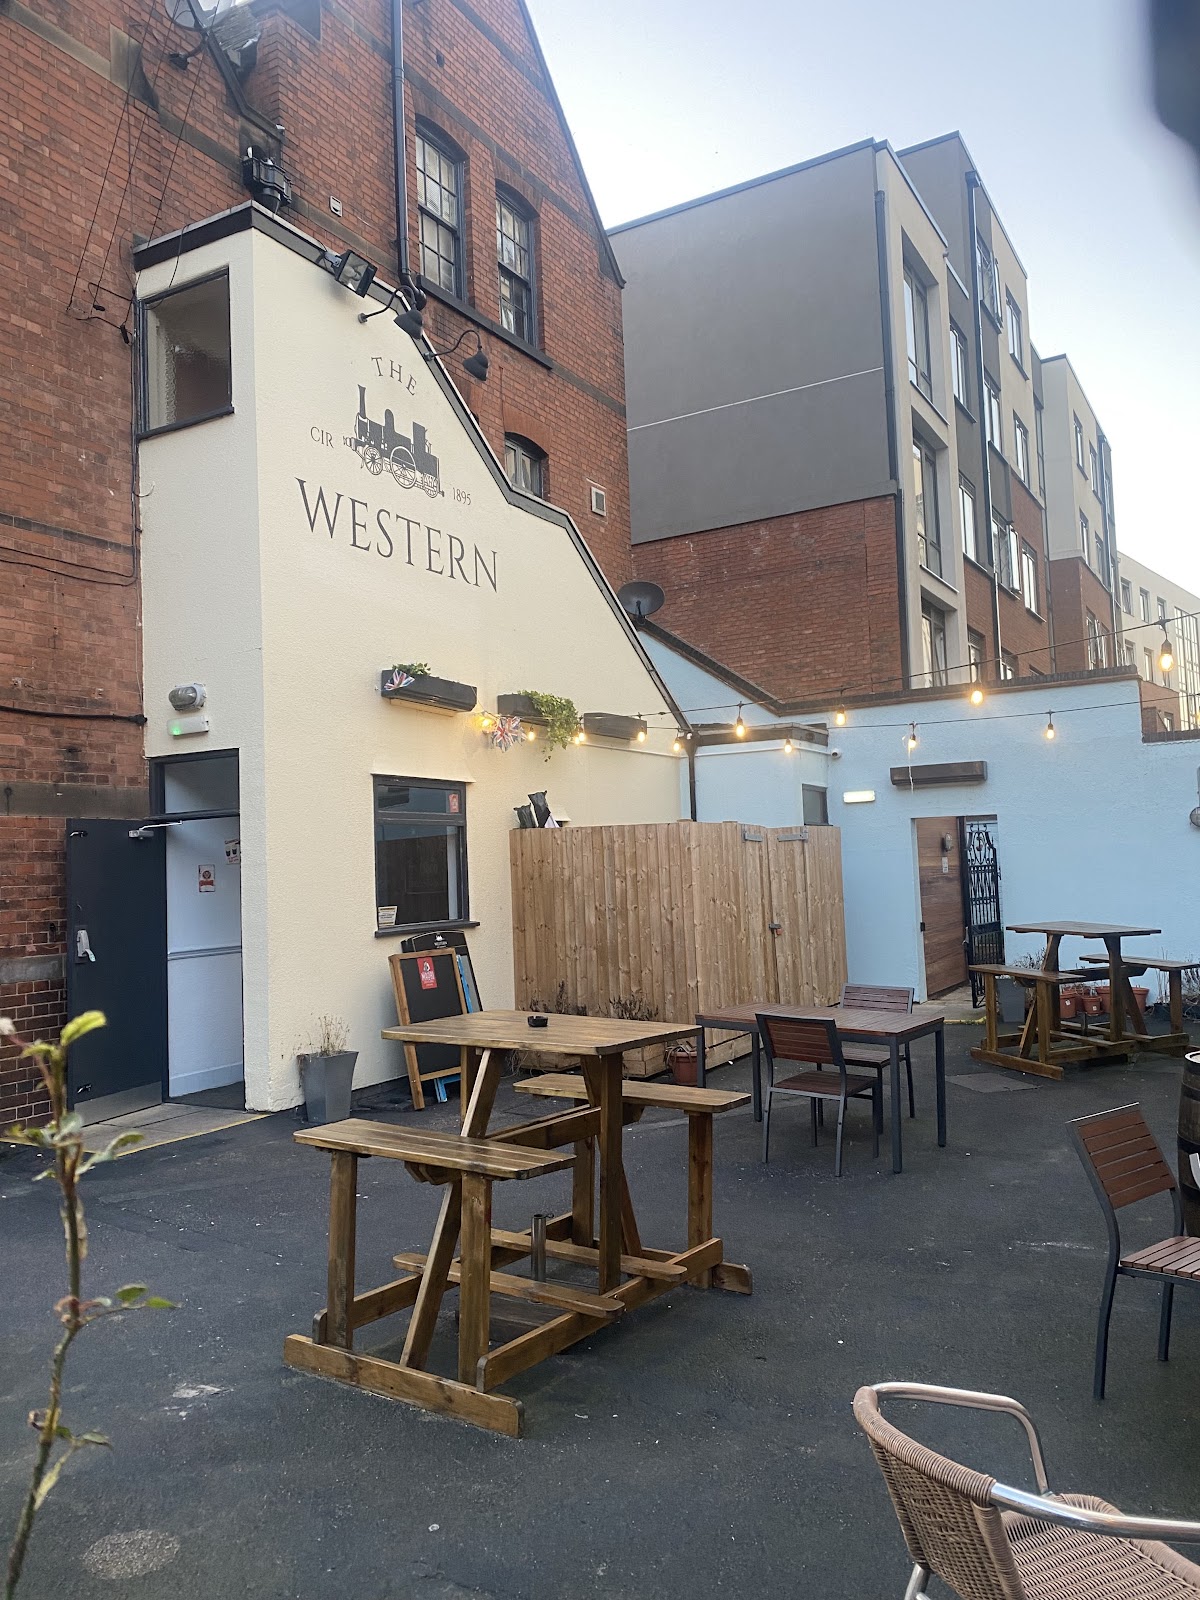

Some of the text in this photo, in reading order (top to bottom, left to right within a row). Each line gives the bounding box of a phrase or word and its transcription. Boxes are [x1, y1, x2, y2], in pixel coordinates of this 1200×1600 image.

[371, 356, 417, 396] THE
[310, 426, 473, 506] CIR 1895
[294, 477, 498, 593] WESTERN
